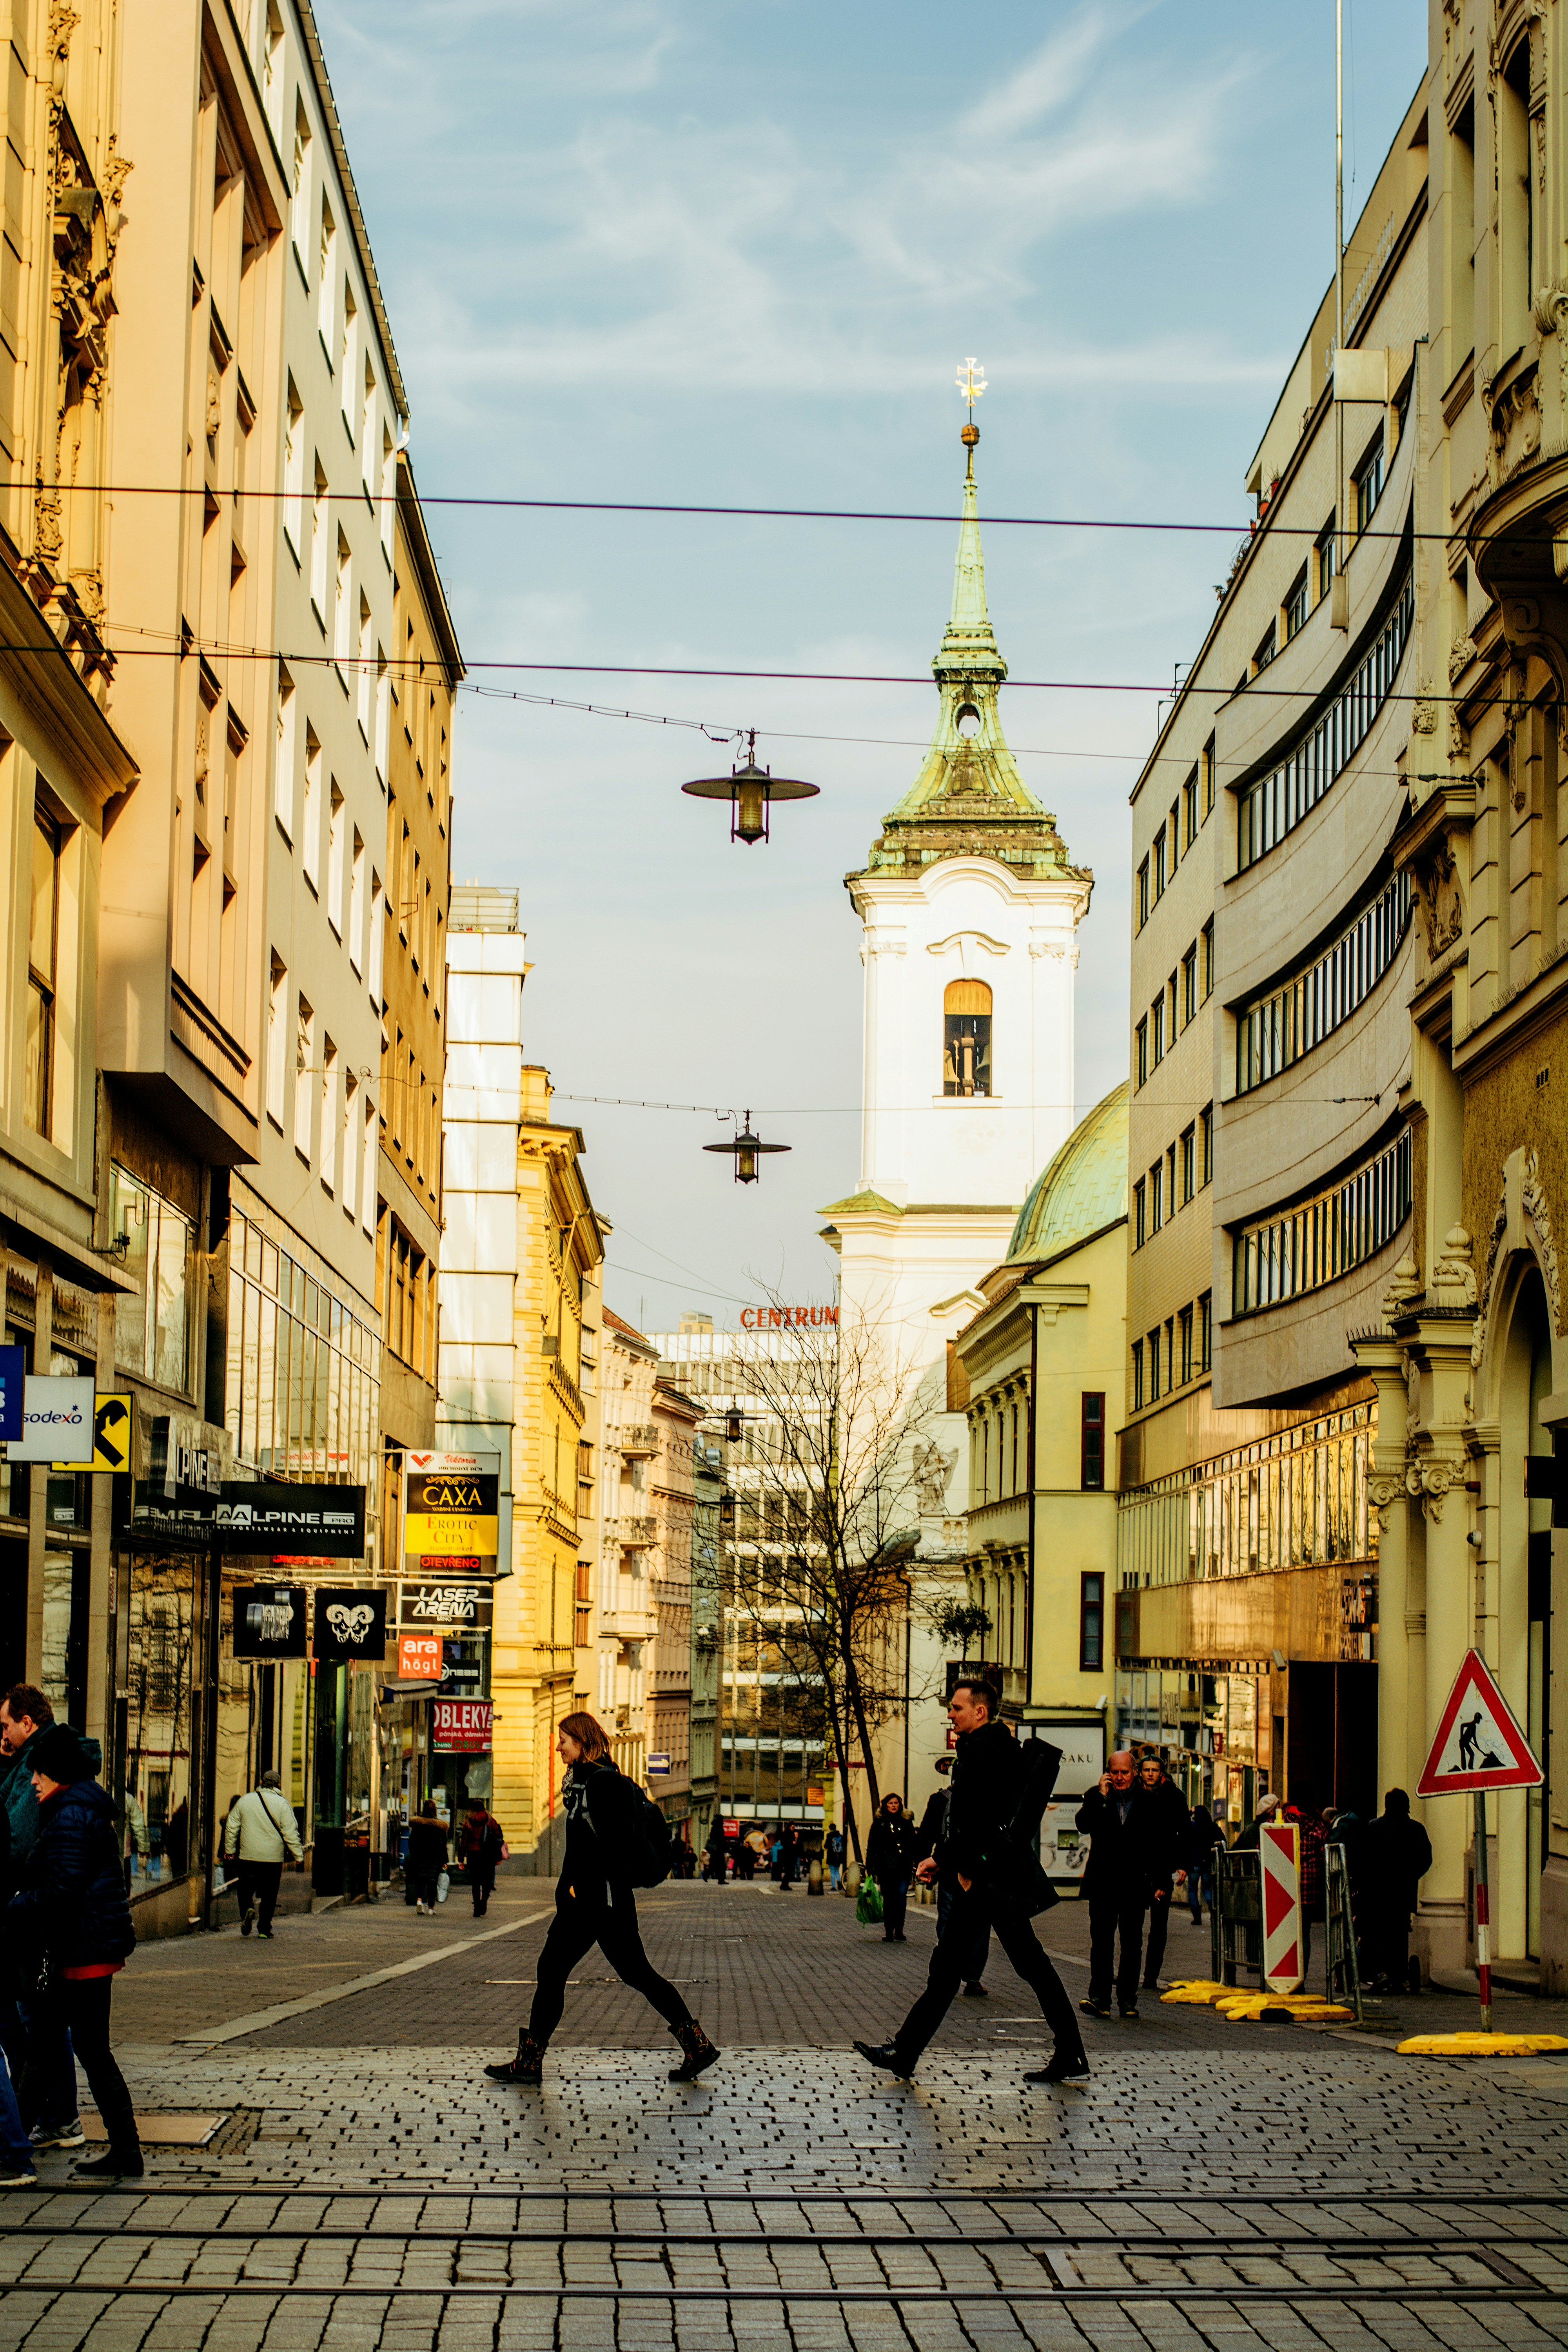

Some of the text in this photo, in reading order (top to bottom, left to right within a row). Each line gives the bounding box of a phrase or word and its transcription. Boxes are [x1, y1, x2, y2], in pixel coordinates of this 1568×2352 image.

[741, 1306, 838, 1327] CENTRUM
[24, 1410, 82, 1424] sodexo
[423, 1486, 482, 1506] CAXA
[231, 1504, 320, 1526] ALPINE
[427, 1516, 477, 1530] EROTIC
[434, 1530, 466, 1543] CITY
[421, 1556, 479, 1568] OTEVŘENO
[419, 1587, 479, 1602] LASER
[412, 1601, 474, 1616] ARENA
[403, 1640, 438, 1654] ara
[454, 1740, 481, 1749] OBUV
